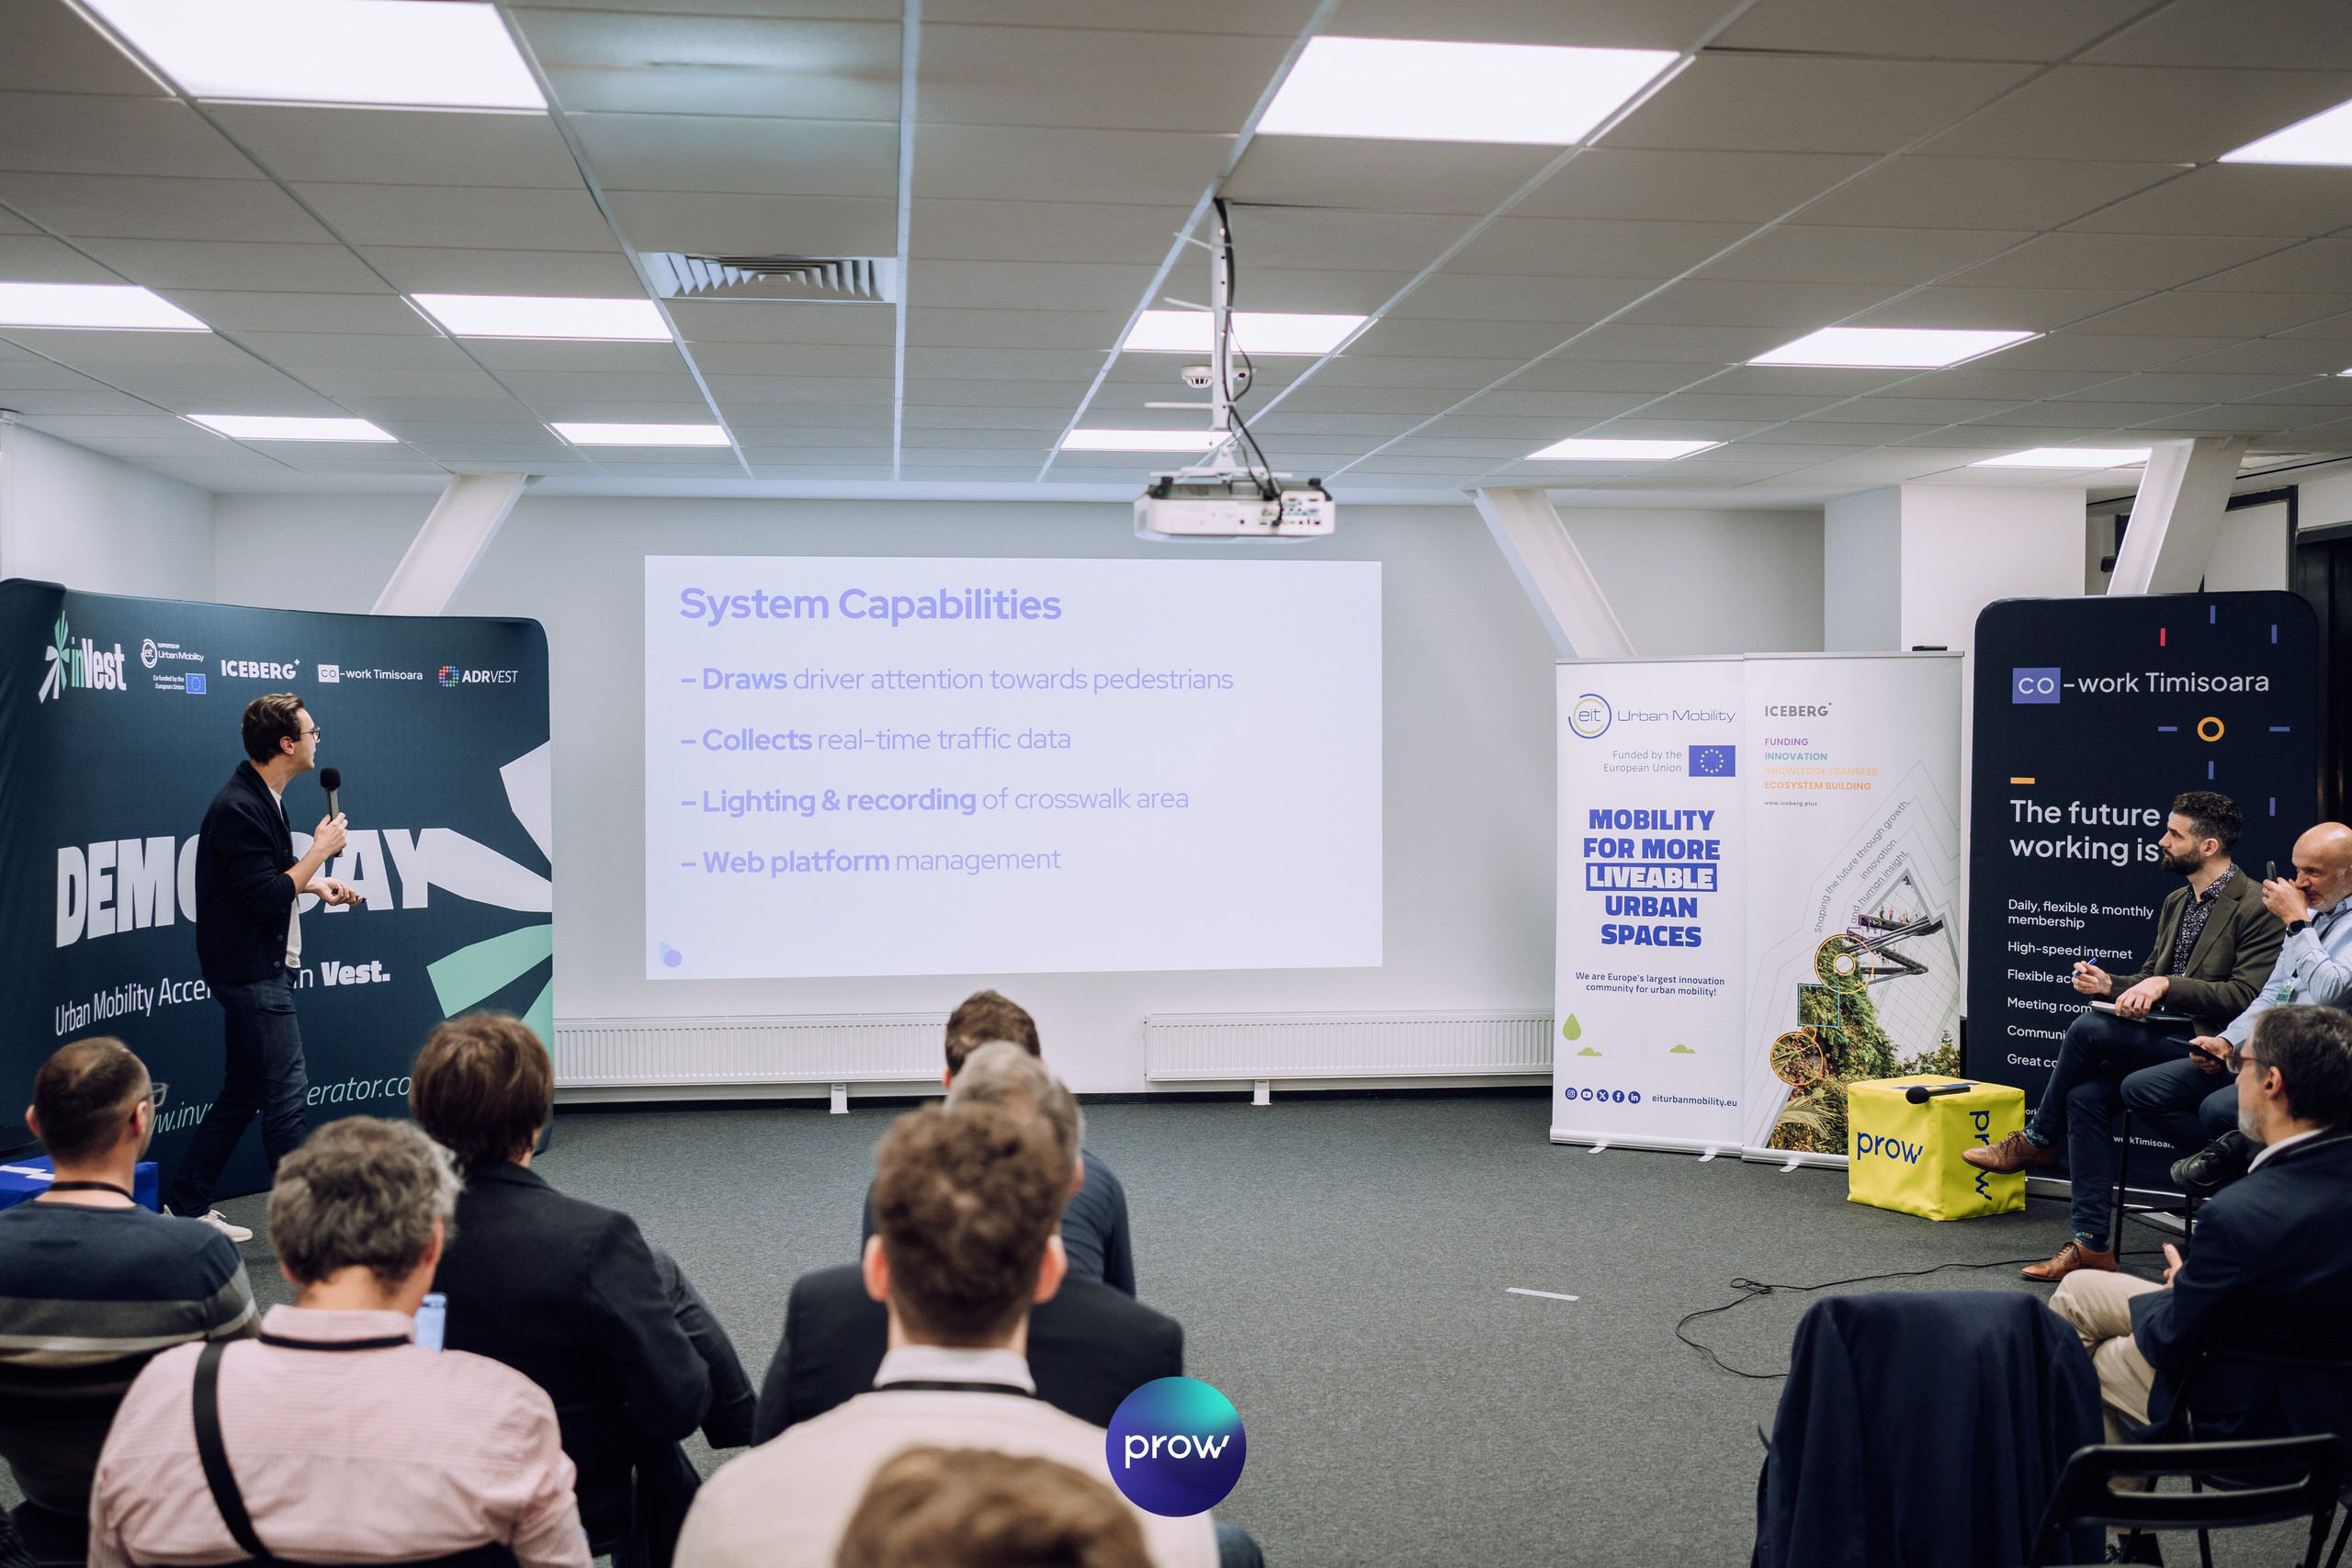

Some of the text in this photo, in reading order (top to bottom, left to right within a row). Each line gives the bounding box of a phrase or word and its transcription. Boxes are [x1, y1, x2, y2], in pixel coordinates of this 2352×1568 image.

[680, 587, 1062, 627] System Capabilities
[71, 637, 127, 691] inVest
[158, 650, 205, 662] Urban Mobility
[373, 669, 423, 681] Timisoara
[461, 670, 518, 683] ADRVEST
[703, 667, 787, 690] Draws
[793, 668, 865, 690] driver
[870, 668, 983, 690] attention
[989, 668, 1088, 690] towards
[1093, 668, 1234, 695] pedestrians
[2145, 671, 2269, 692] Timisoara
[1578, 708, 1601, 722] eit
[1618, 709, 1736, 724] Urban Mobility
[703, 728, 813, 751] Collects
[818, 728, 932, 750] real-time
[937, 727, 1012, 750] traffic
[1016, 728, 1071, 750] data
[1764, 738, 1809, 746] FUNDING
[1612, 750, 1682, 761] Funded by the
[1764, 752, 1827, 761] INNOVATION
[1604, 763, 1682, 773] European Union
[1764, 767, 1879, 776] KNOWLEDGE TRANSFER
[1764, 781, 1871, 791] ECOSYSTEM BUILDING
[703, 788, 816, 818] Lighting
[821, 788, 842, 812] &
[846, 786, 977, 817] recording
[982, 786, 1010, 810] of
[1014, 787, 1131, 809] crosswalk
[1136, 790, 1190, 809] area
[1589, 809, 1715, 831] MOBILITY
[2009, 799, 2062, 824] The
[2068, 801, 2160, 827] future
[1583, 837, 1721, 860] FOR MORE
[2009, 835, 2160, 867] working is
[703, 851, 764, 874] Web
[771, 848, 890, 879] platform
[896, 849, 1062, 875] management
[1814, 800, 1911, 933] Shaping the future through growth,
[1859, 839, 1897, 880] innovation
[1589, 865, 1714, 890] LIVEABLE
[1605, 895, 1698, 919] URBAN
[1850, 905, 1860, 924] and
[1858, 875, 1885, 906] human
[2008, 898, 2154, 919] Daily, flexible & monthly
[2007, 915, 2086, 930] membership
[1600, 923, 1702, 948] SPACES
[2007, 941, 2133, 960] High-speed internet
[1576, 972, 1589, 980] We
[1608, 973, 1645, 985] Europe's
[1646, 975, 1677, 986] largest
[1679, 976, 1725, 986] innovation
[2007, 969, 2054, 983] Flexible
[55, 1001, 90, 1036] Urban
[94, 981, 154, 1022] Mobility
[321, 960, 390, 987] Vest.
[1586, 984, 1716, 998] community for urban mobility!
[2007, 997, 2057, 1013] Meeting
[2007, 1054, 2041, 1067] Great
[1652, 1094, 1737, 1108] eiturbanmobility.eu
[1857, 1132, 1924, 1165] prow
[1969, 1110, 1992, 1201] prw
